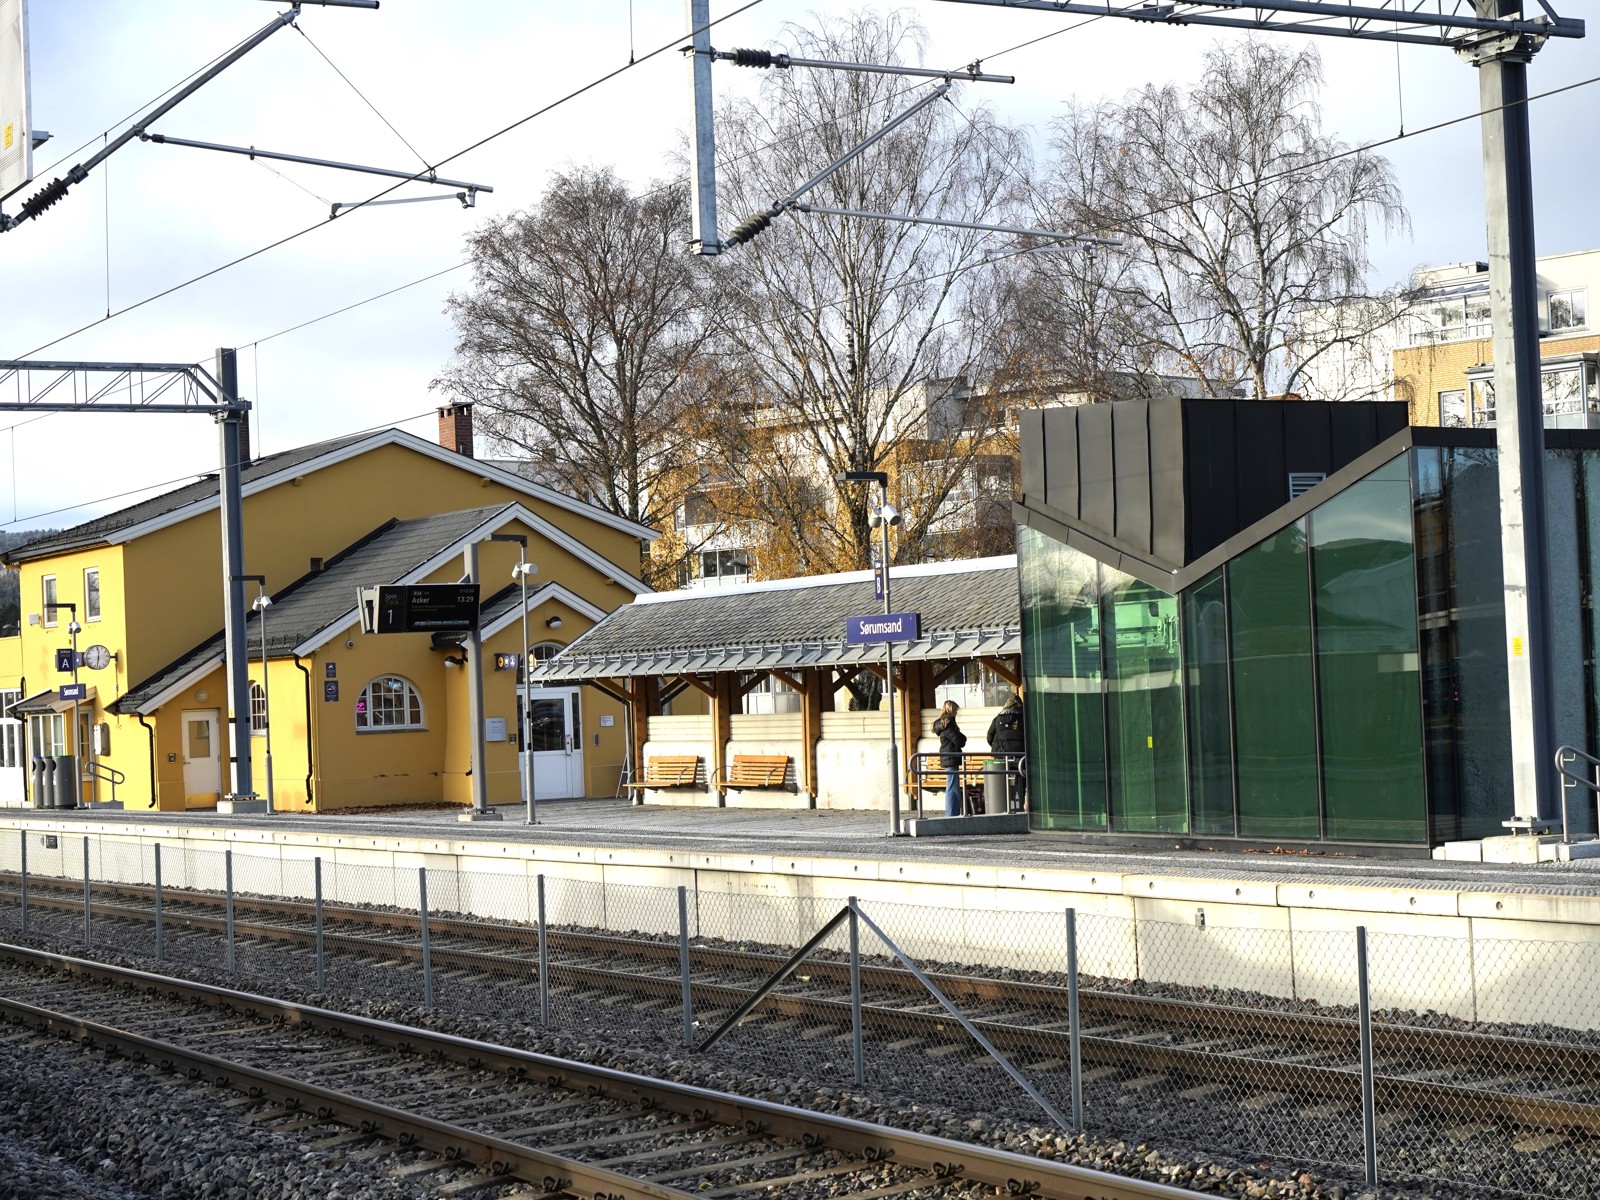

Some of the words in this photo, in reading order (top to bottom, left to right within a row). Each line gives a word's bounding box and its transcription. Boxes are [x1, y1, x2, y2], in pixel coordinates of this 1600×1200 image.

[876, 577, 881, 594] B
[457, 596, 475, 604] 13:29
[387, 609, 393, 625] 1
[860, 618, 902, 636] Sørumsand
[61, 658, 70, 668] A
